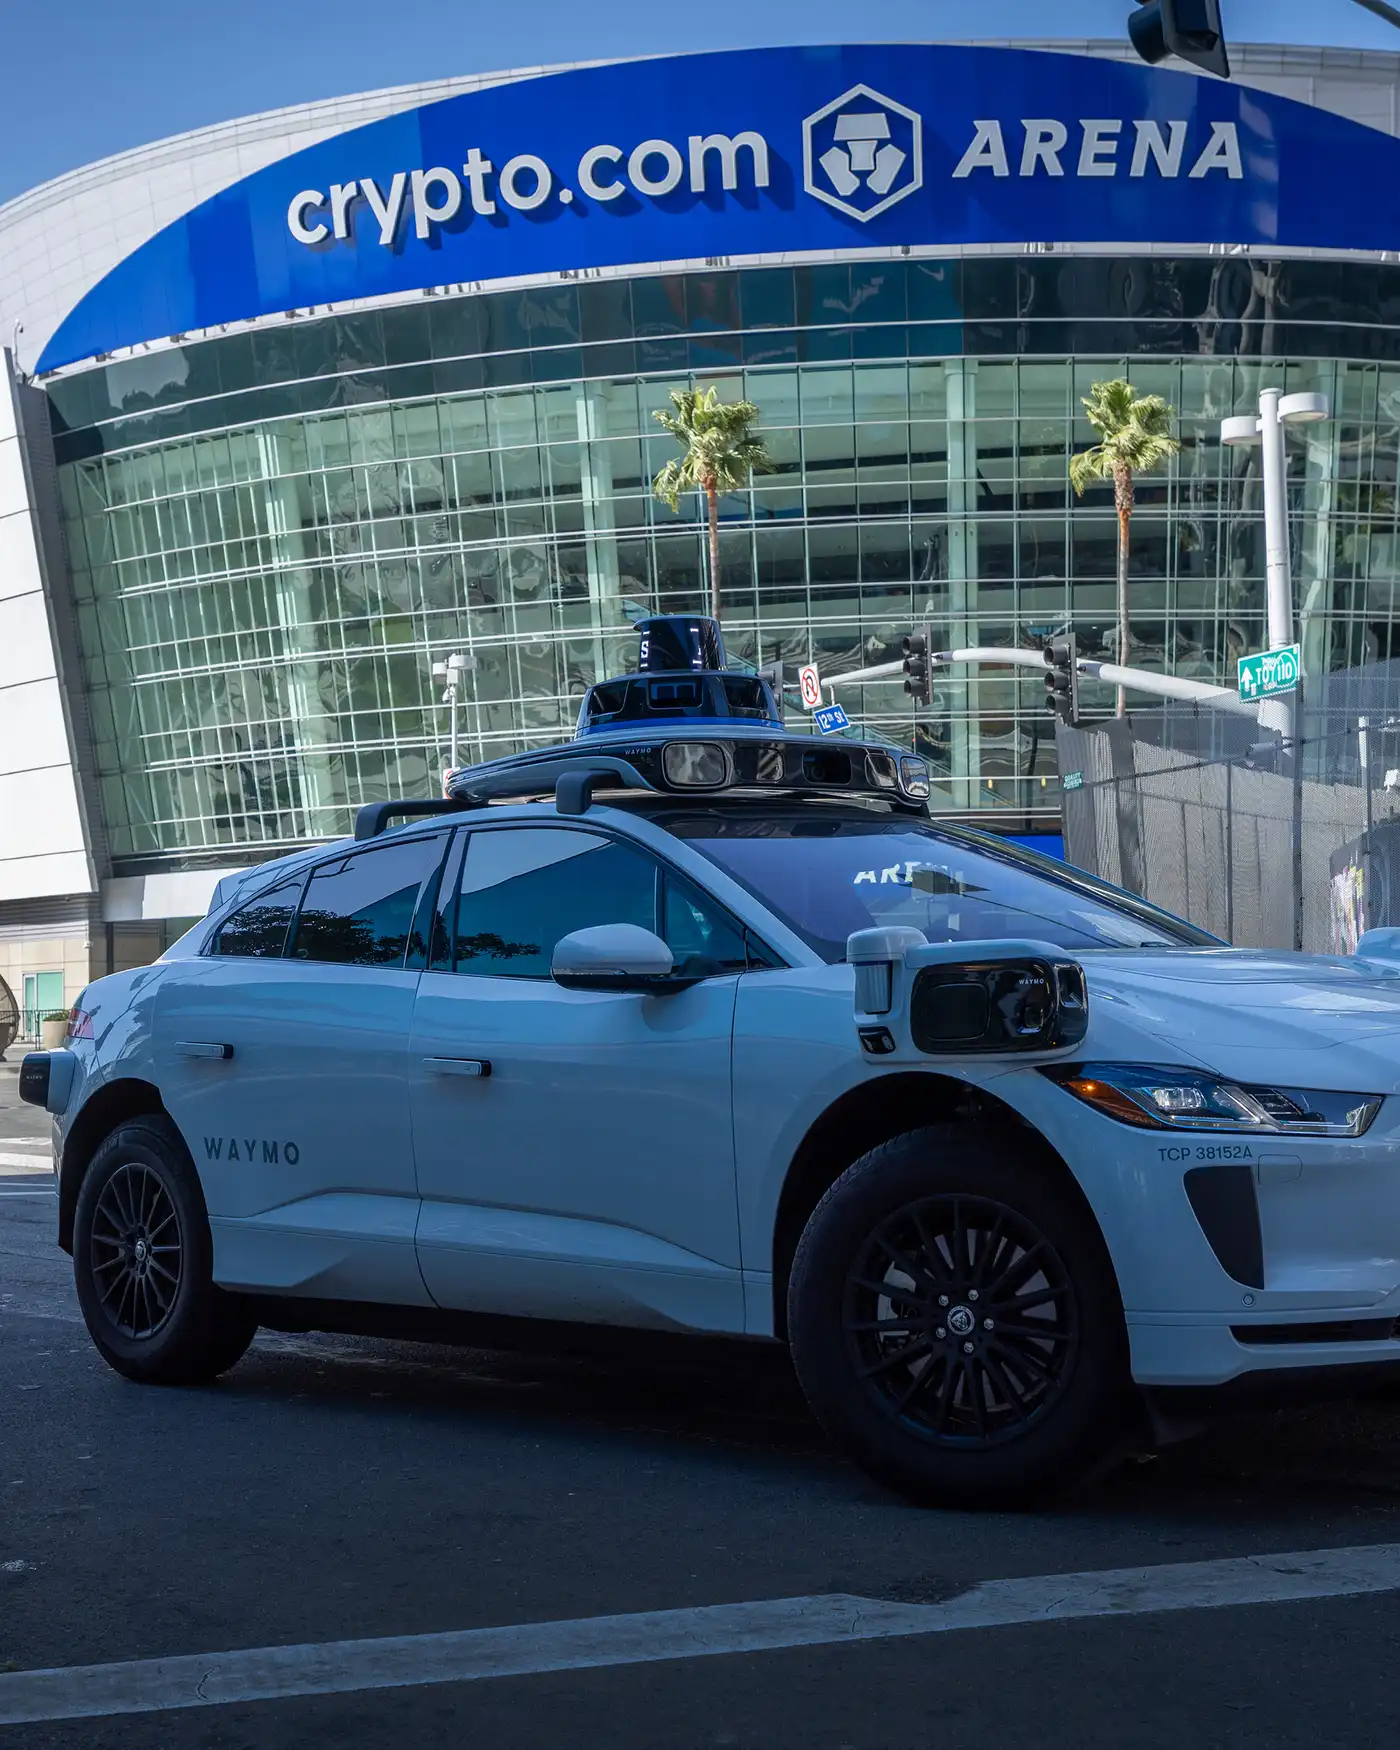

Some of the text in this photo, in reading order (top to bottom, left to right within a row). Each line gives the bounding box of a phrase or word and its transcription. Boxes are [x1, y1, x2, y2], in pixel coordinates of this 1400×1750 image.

[288, 119, 1244, 245] crypto.com ARENA
[203, 1136, 300, 1166] WAYMO
[1157, 1145, 1253, 1162] TCP 38152A
